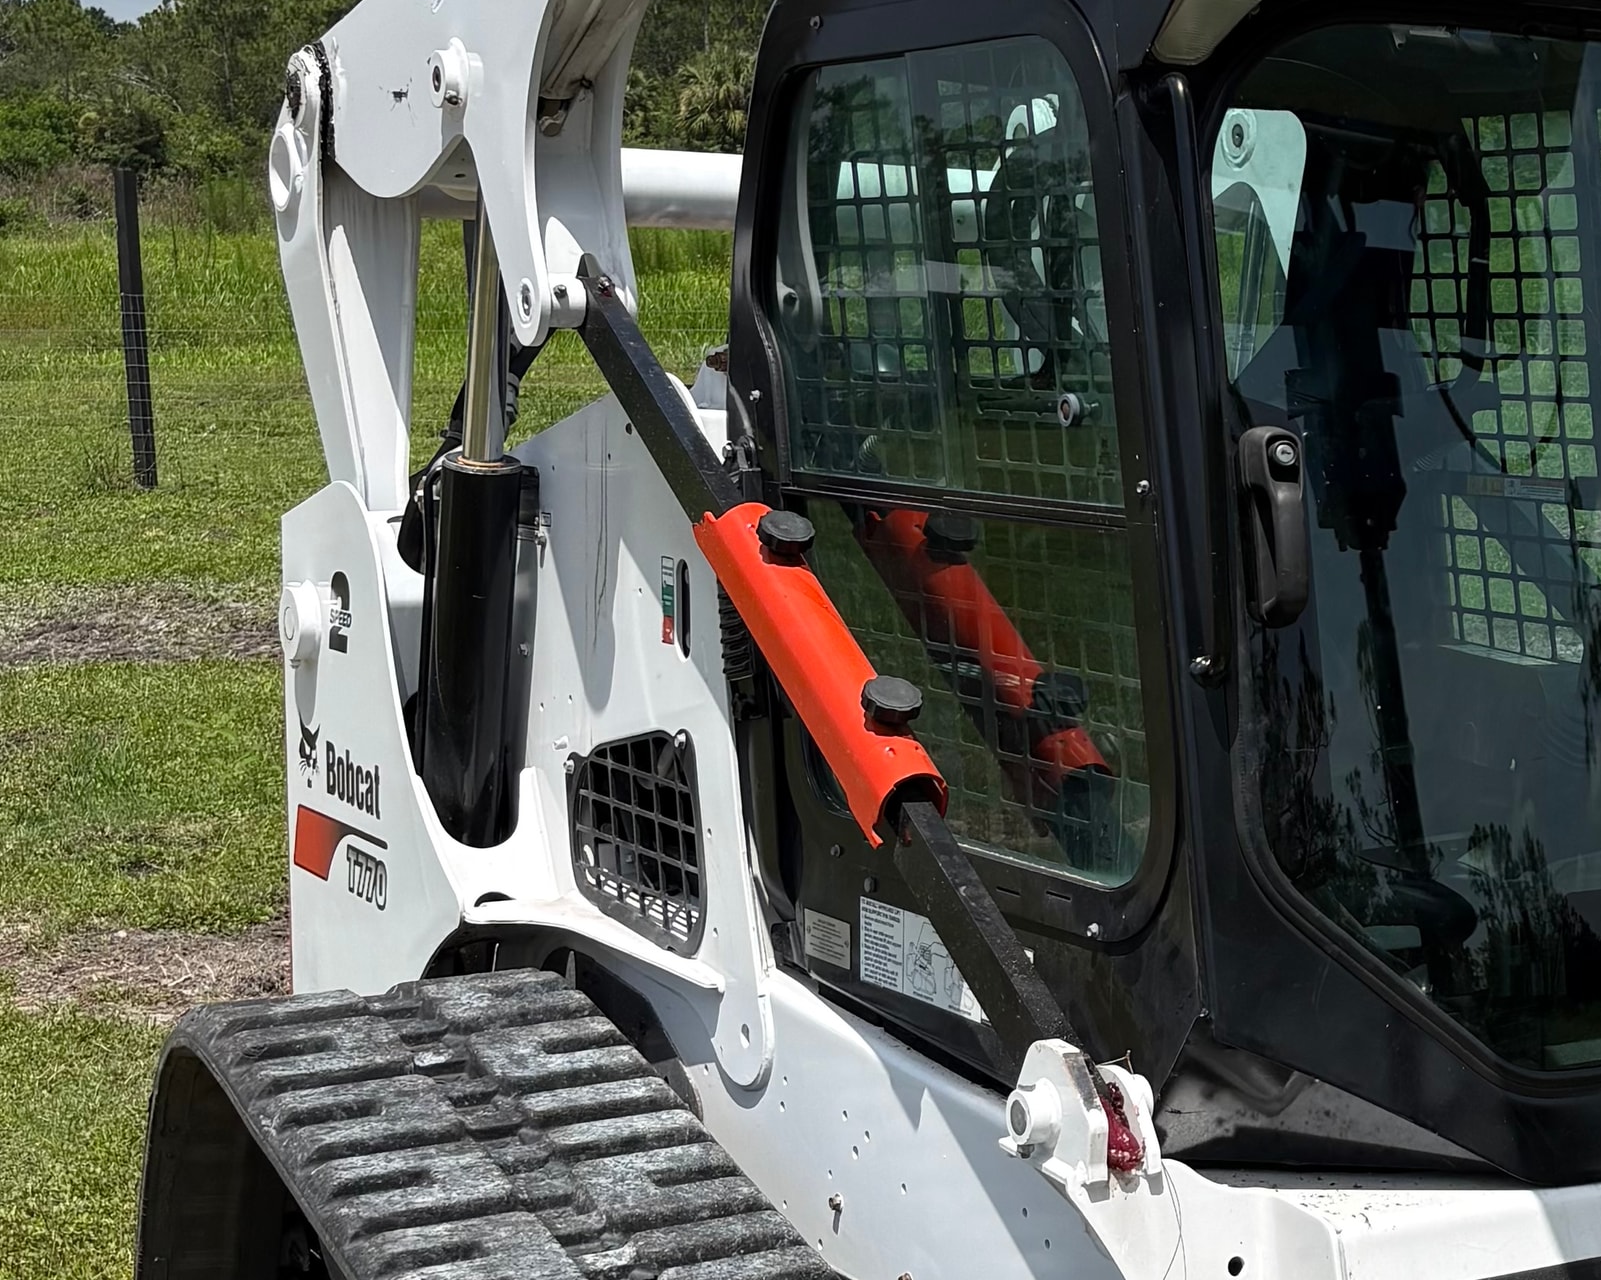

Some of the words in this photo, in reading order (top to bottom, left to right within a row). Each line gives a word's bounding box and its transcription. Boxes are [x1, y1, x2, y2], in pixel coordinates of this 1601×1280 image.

[329, 571, 350, 654] 2
[329, 609, 352, 628] SPEED
[326, 740, 381, 820] Bobcat
[346, 844, 388, 911] T770
